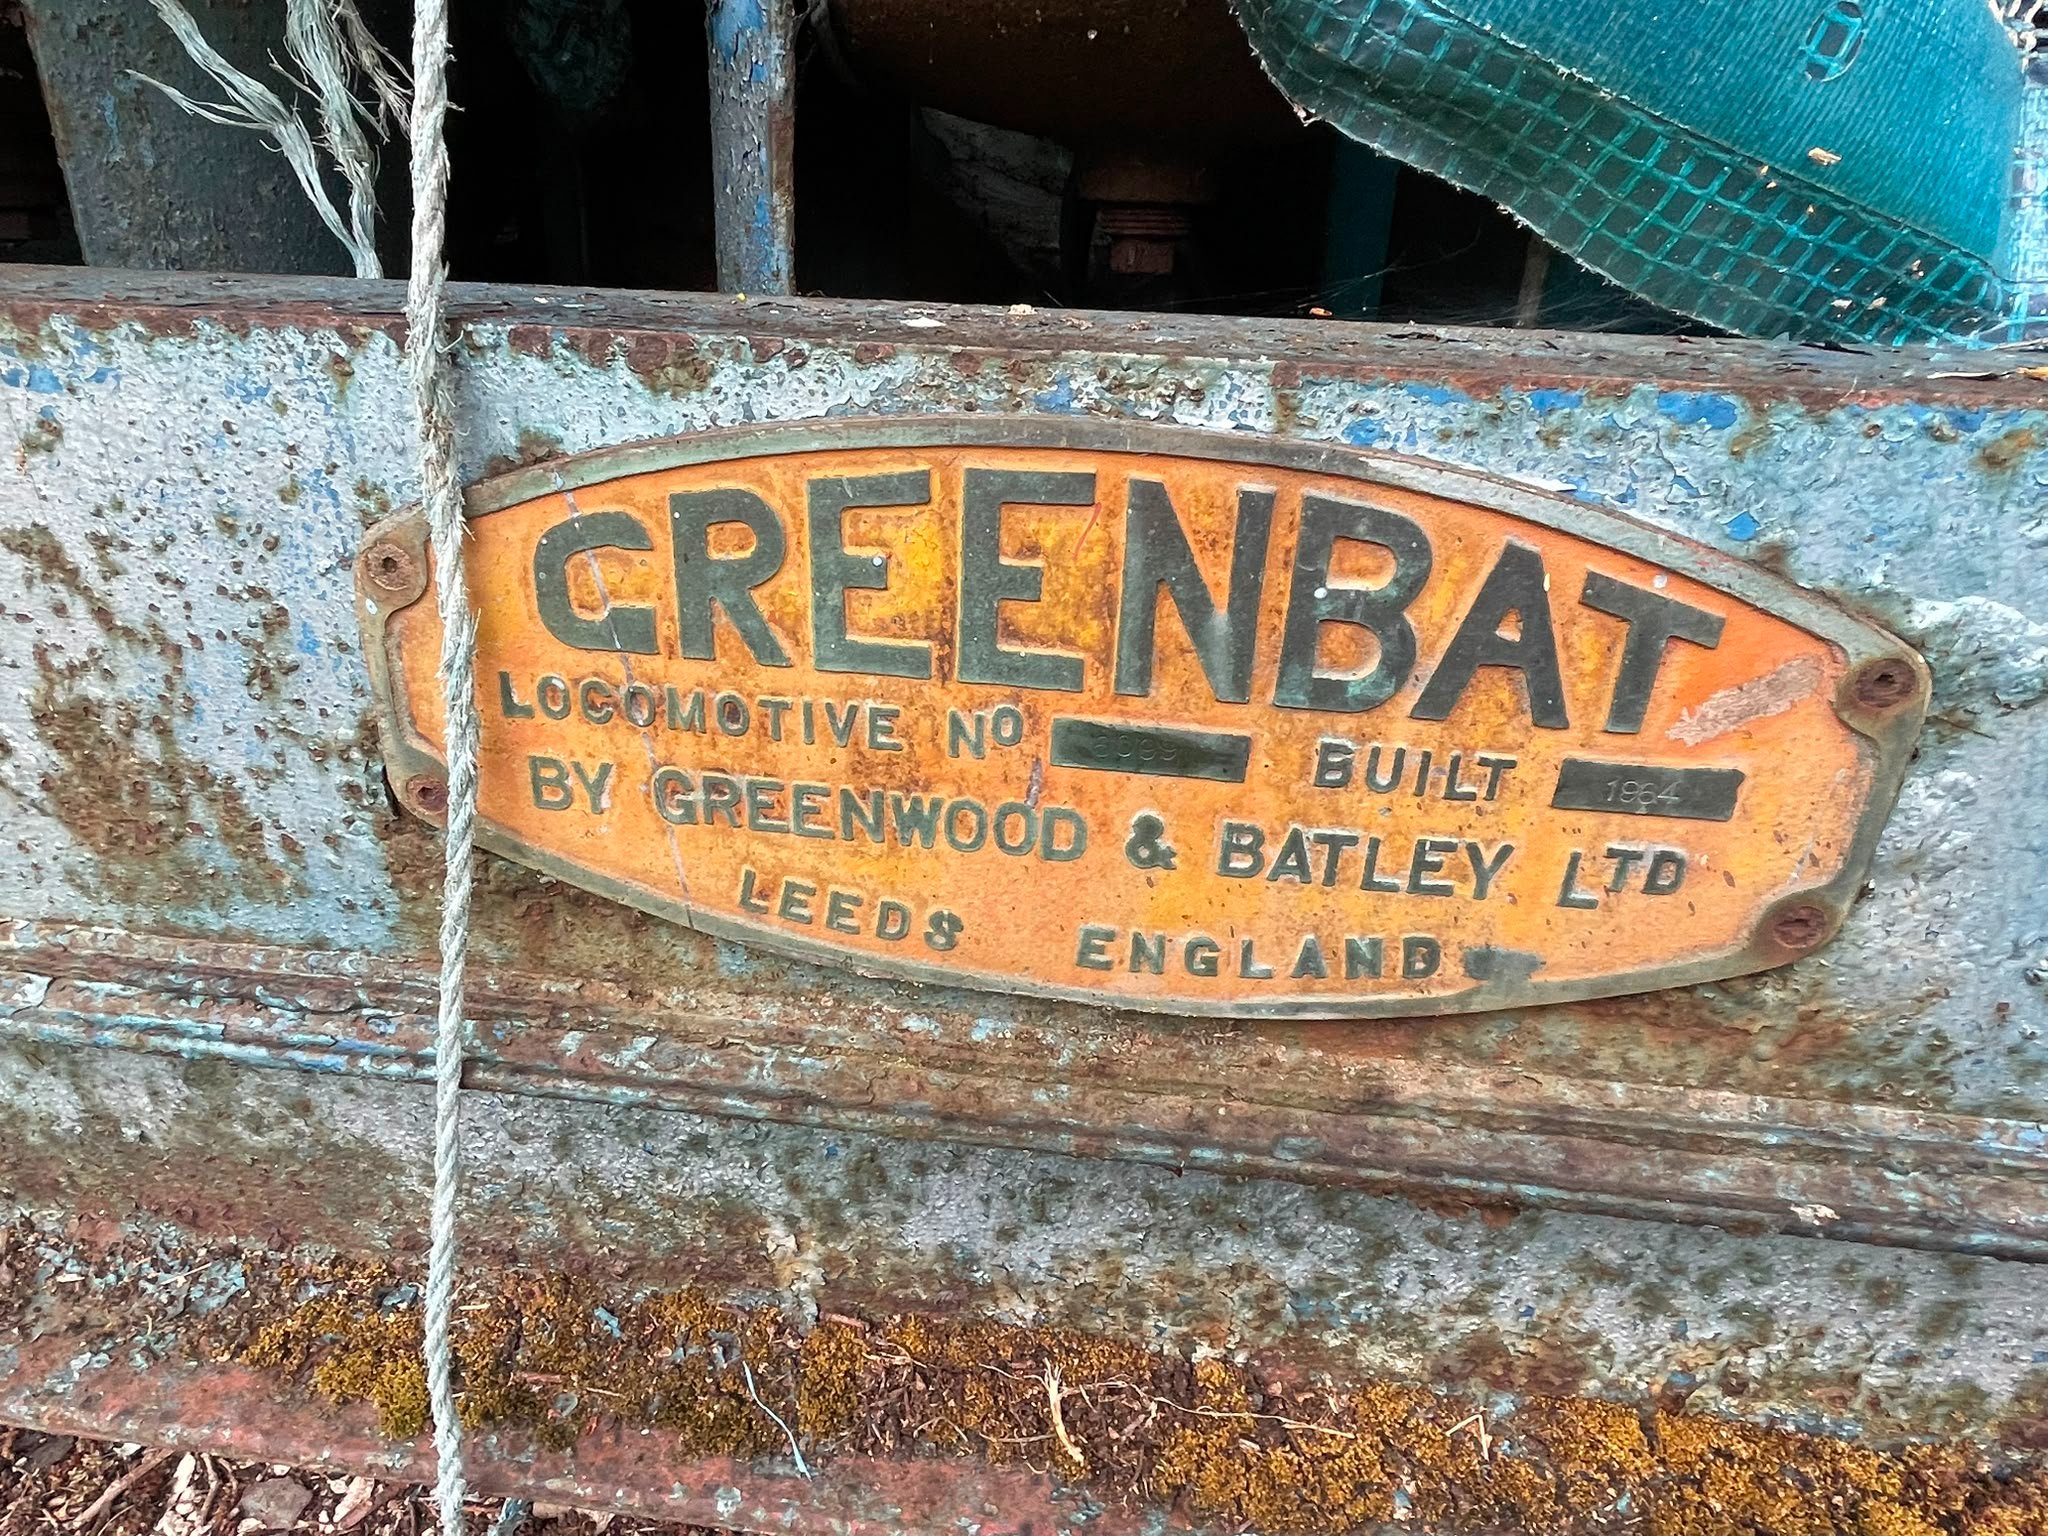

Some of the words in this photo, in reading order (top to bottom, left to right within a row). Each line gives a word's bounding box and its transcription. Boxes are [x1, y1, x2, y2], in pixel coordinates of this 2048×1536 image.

[534, 466, 1727, 733] GREENBAT
[499, 671, 903, 751] LOCOMOTIVE
[1313, 736, 1518, 802] BUILT
[1606, 775, 1682, 805] 1964
[528, 754, 614, 815] BY
[651, 765, 1088, 862] GREENWOOD
[1124, 812, 1176, 870] &
[1216, 819, 1516, 900] BATLEY
[1556, 846, 1688, 909] LTD
[737, 868, 965, 951] LEEDS
[1075, 925, 1441, 980] ENGLAND
